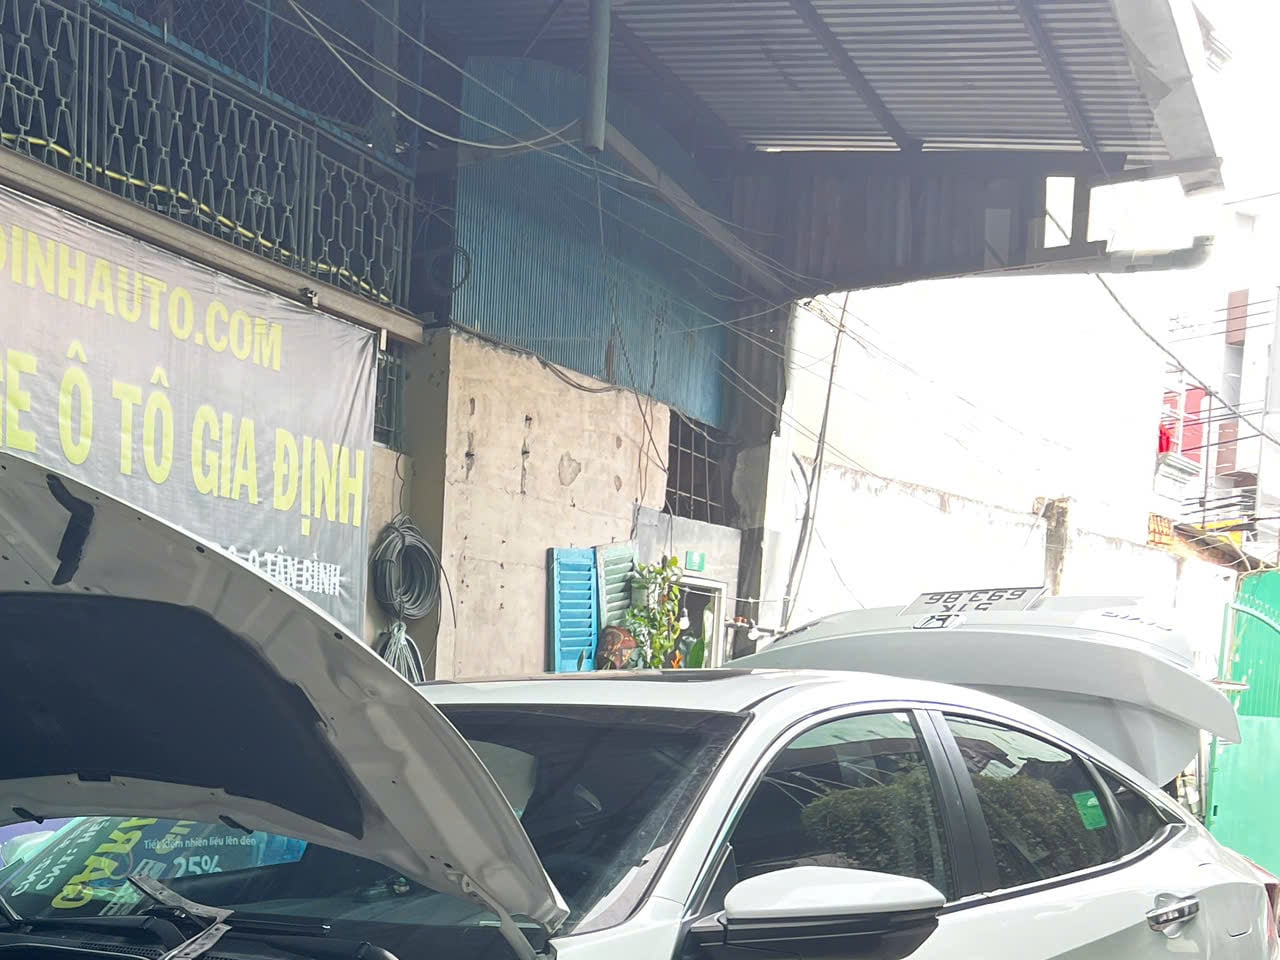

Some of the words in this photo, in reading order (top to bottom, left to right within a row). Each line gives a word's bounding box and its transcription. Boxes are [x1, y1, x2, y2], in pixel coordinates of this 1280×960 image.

[58, 340, 94, 466] Ô
[111, 366, 174, 486] TÔ
[190, 404, 260, 505] GIA
[272, 427, 365, 537] ĐỊNH
[300, 552, 341, 597] BÌNH
[184, 837, 208, 848] nhiên
[225, 835, 239, 846] lên
[173, 855, 223, 878] 25%
